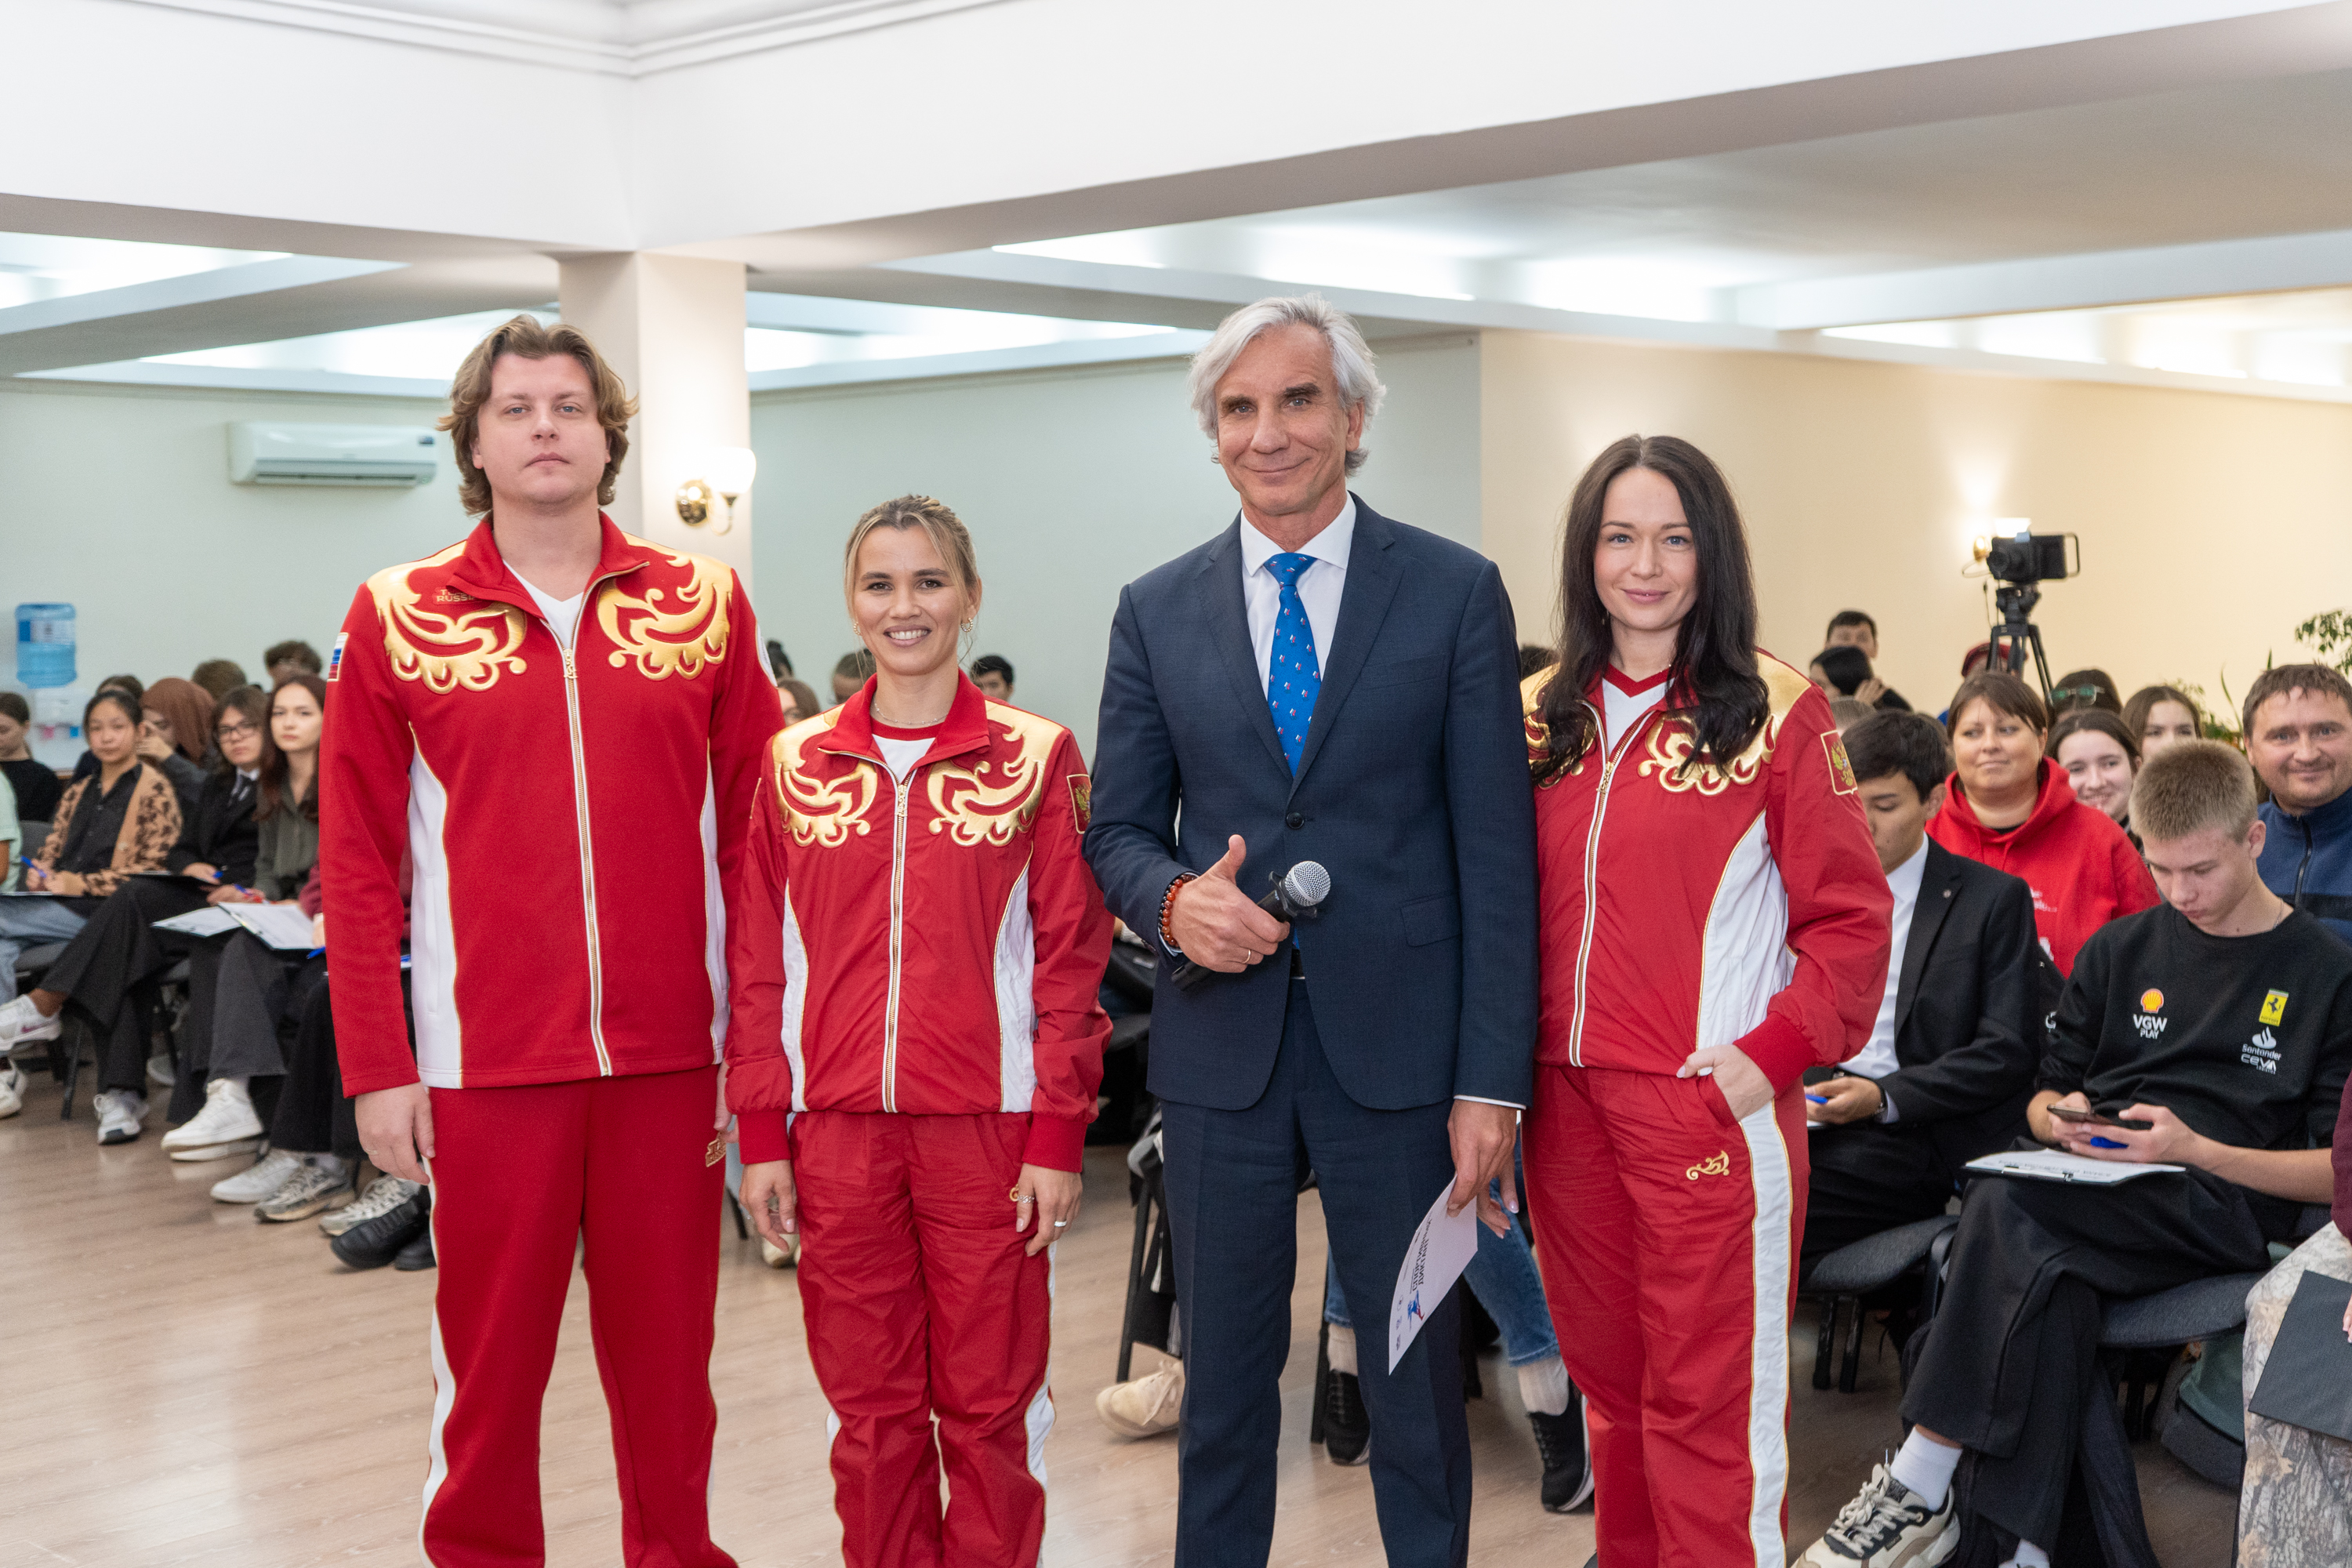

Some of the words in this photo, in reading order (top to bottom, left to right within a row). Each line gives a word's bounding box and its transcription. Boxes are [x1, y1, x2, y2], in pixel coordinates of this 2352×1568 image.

[2133, 1014, 2168, 1033] VGW
[2140, 1027, 2159, 1040] PLAY
[2241, 1044, 2282, 1062] Santander
[1417, 1236, 1429, 1286] ДИКТАНТ
